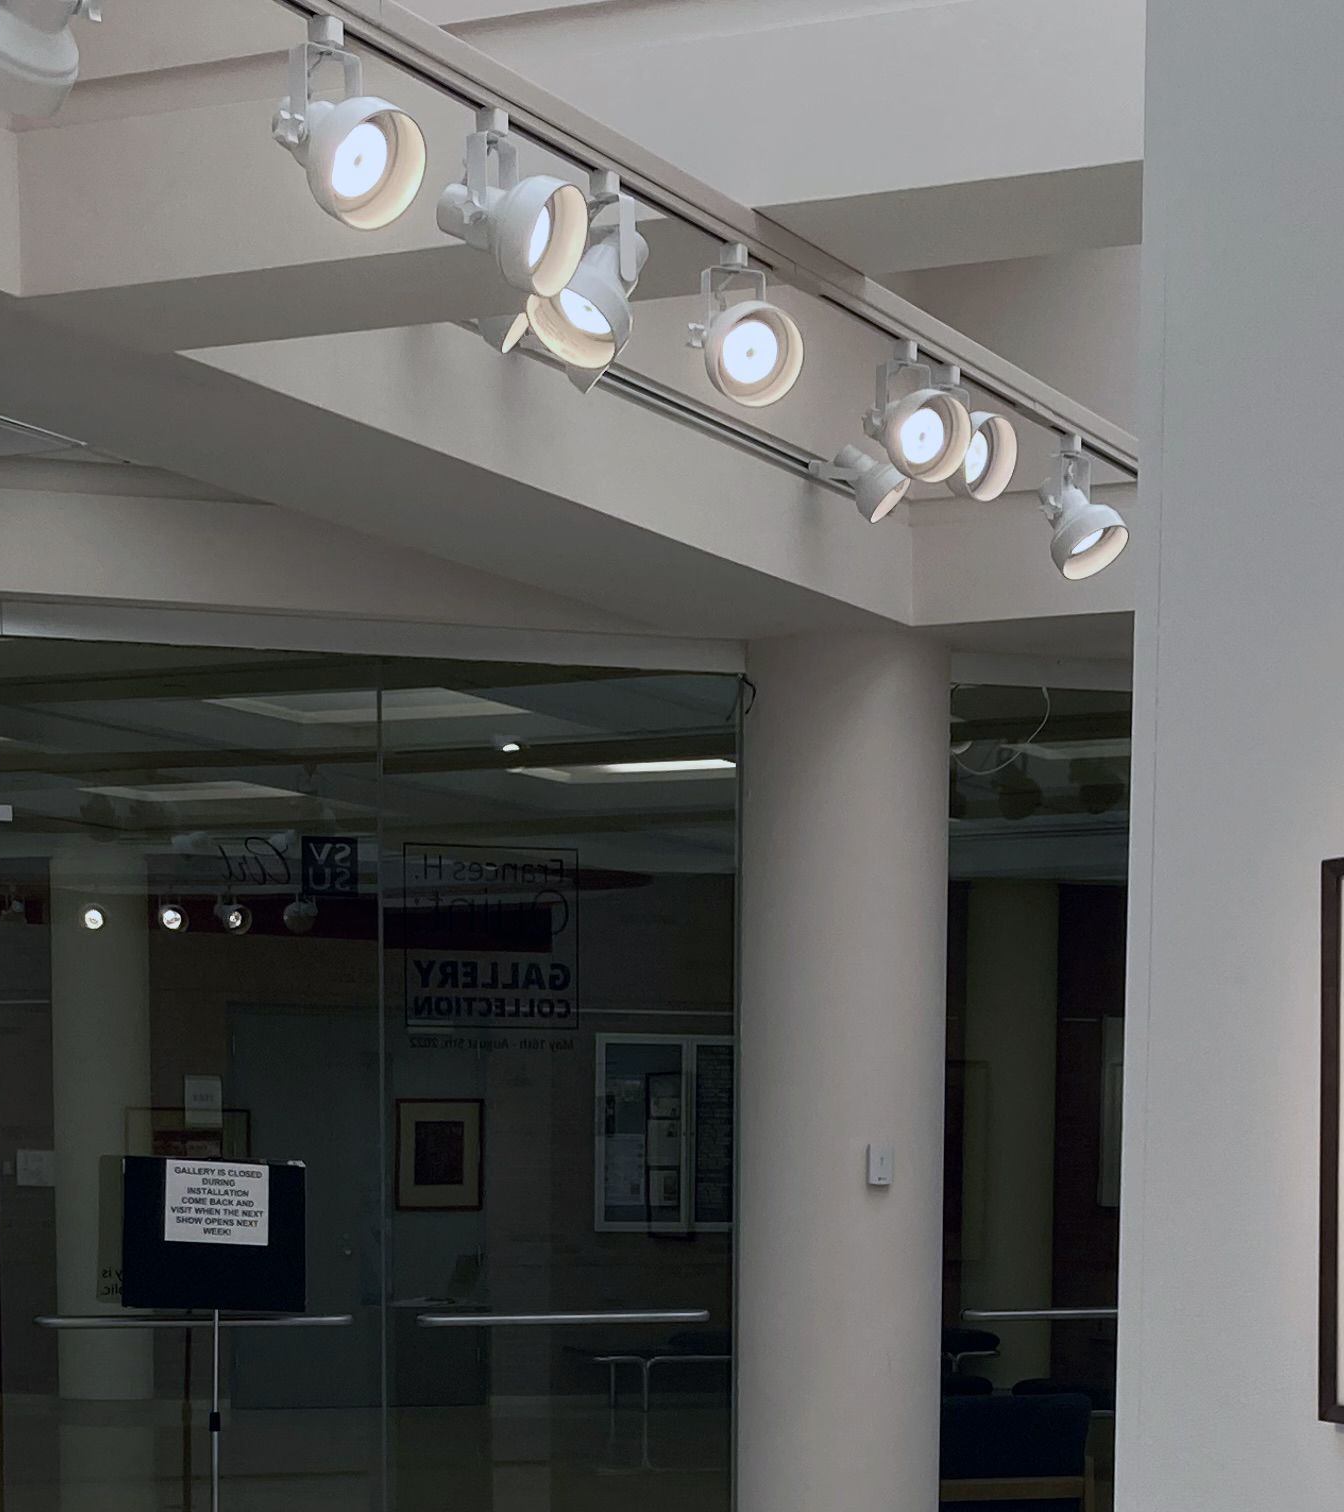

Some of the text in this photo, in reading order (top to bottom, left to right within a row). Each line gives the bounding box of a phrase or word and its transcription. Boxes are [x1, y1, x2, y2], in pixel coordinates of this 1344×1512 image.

[174, 1166, 263, 1179] GALLERY IS CLOSED
[201, 1177, 236, 1187] DURING
[187, 1186, 249, 1197] INSTALLATION
[181, 1196, 254, 1208] COME BACK AND
[170, 1206, 264, 1218] VISIT WHEN THE NEXT
[175, 1216, 259, 1228] SHOW OPENS NEXT
[203, 1227, 232, 1236] WEEK!
